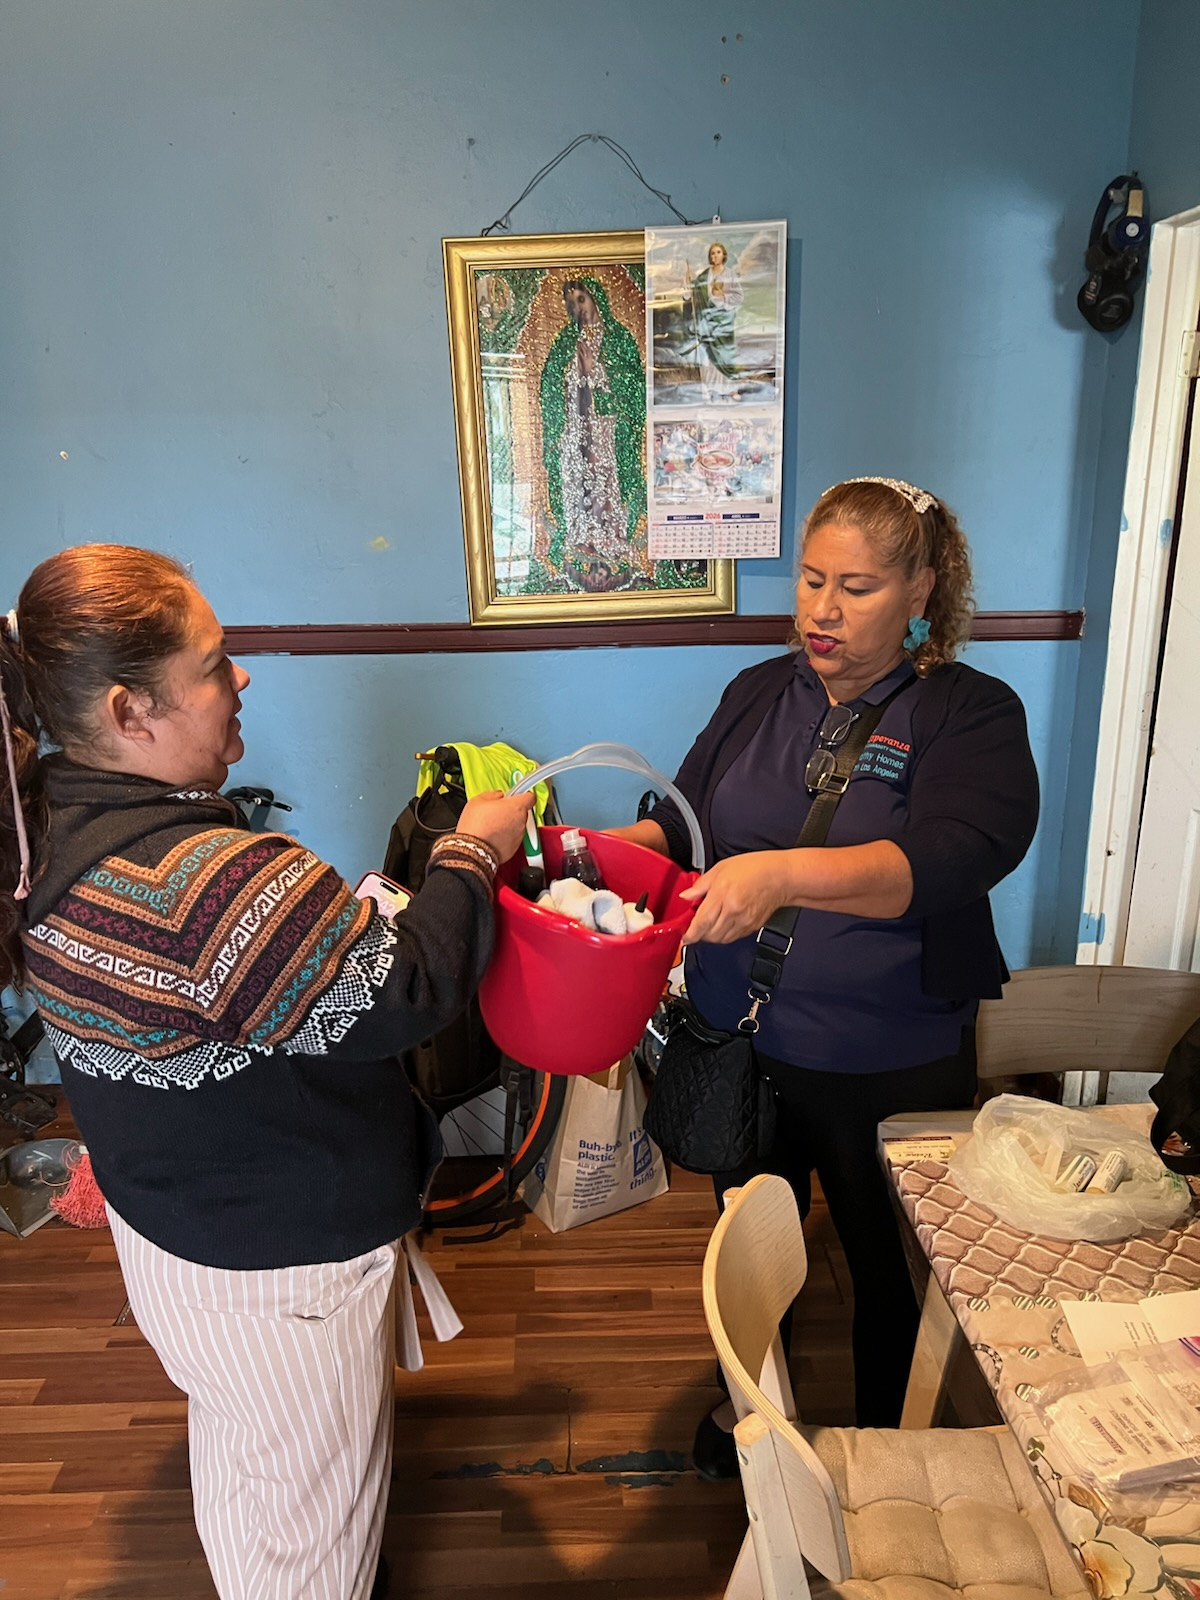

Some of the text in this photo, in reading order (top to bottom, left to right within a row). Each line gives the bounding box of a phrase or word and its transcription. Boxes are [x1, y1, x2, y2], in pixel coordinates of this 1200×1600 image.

[705, 512, 721, 520] 2026
[876, 753, 904, 770] Homes
[860, 763, 871, 772] Los
[872, 764, 899, 779] Angeles
[578, 1151, 616, 1162] plastic.
[630, 1167, 657, 1190] thing.
